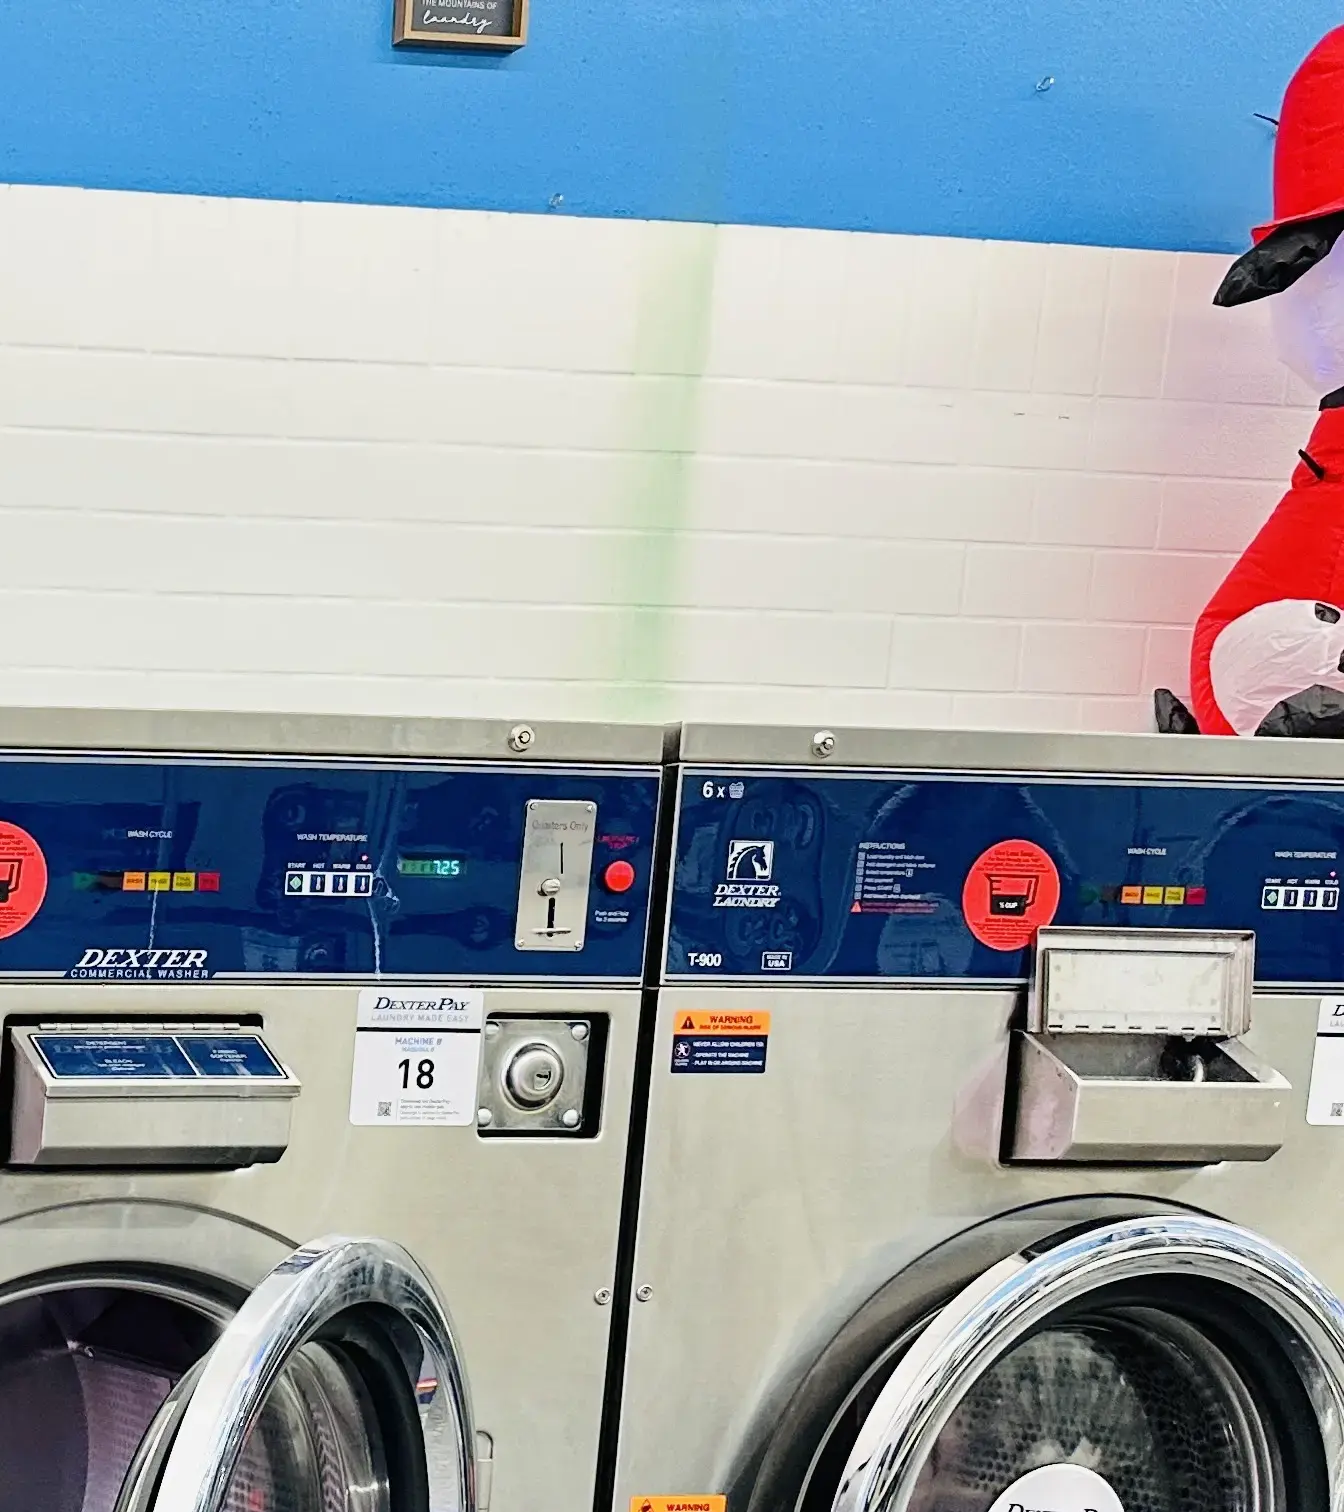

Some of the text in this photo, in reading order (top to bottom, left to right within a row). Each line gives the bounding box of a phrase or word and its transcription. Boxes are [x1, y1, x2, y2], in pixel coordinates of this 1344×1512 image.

[438, 0, 484, 8] MOUNTAINS
[423, 10, 492, 34] laundry
[702, 782, 724, 798] 6 x
[532, 820, 588, 832] Quarters Only
[319, 834, 367, 842] TEMPERATURE
[715, 885, 779, 897] DEXTER
[713, 897, 780, 907] LAUNDRY
[75, 950, 207, 967] DEXTER
[688, 953, 722, 966] T-900
[767, 960, 785, 968] USA
[70, 969, 208, 978] COMMERCIAL WASHER
[447, 1015, 469, 1023] EASY
[395, 1037, 434, 1045] MACHINE
[398, 1059, 435, 1089] 18
